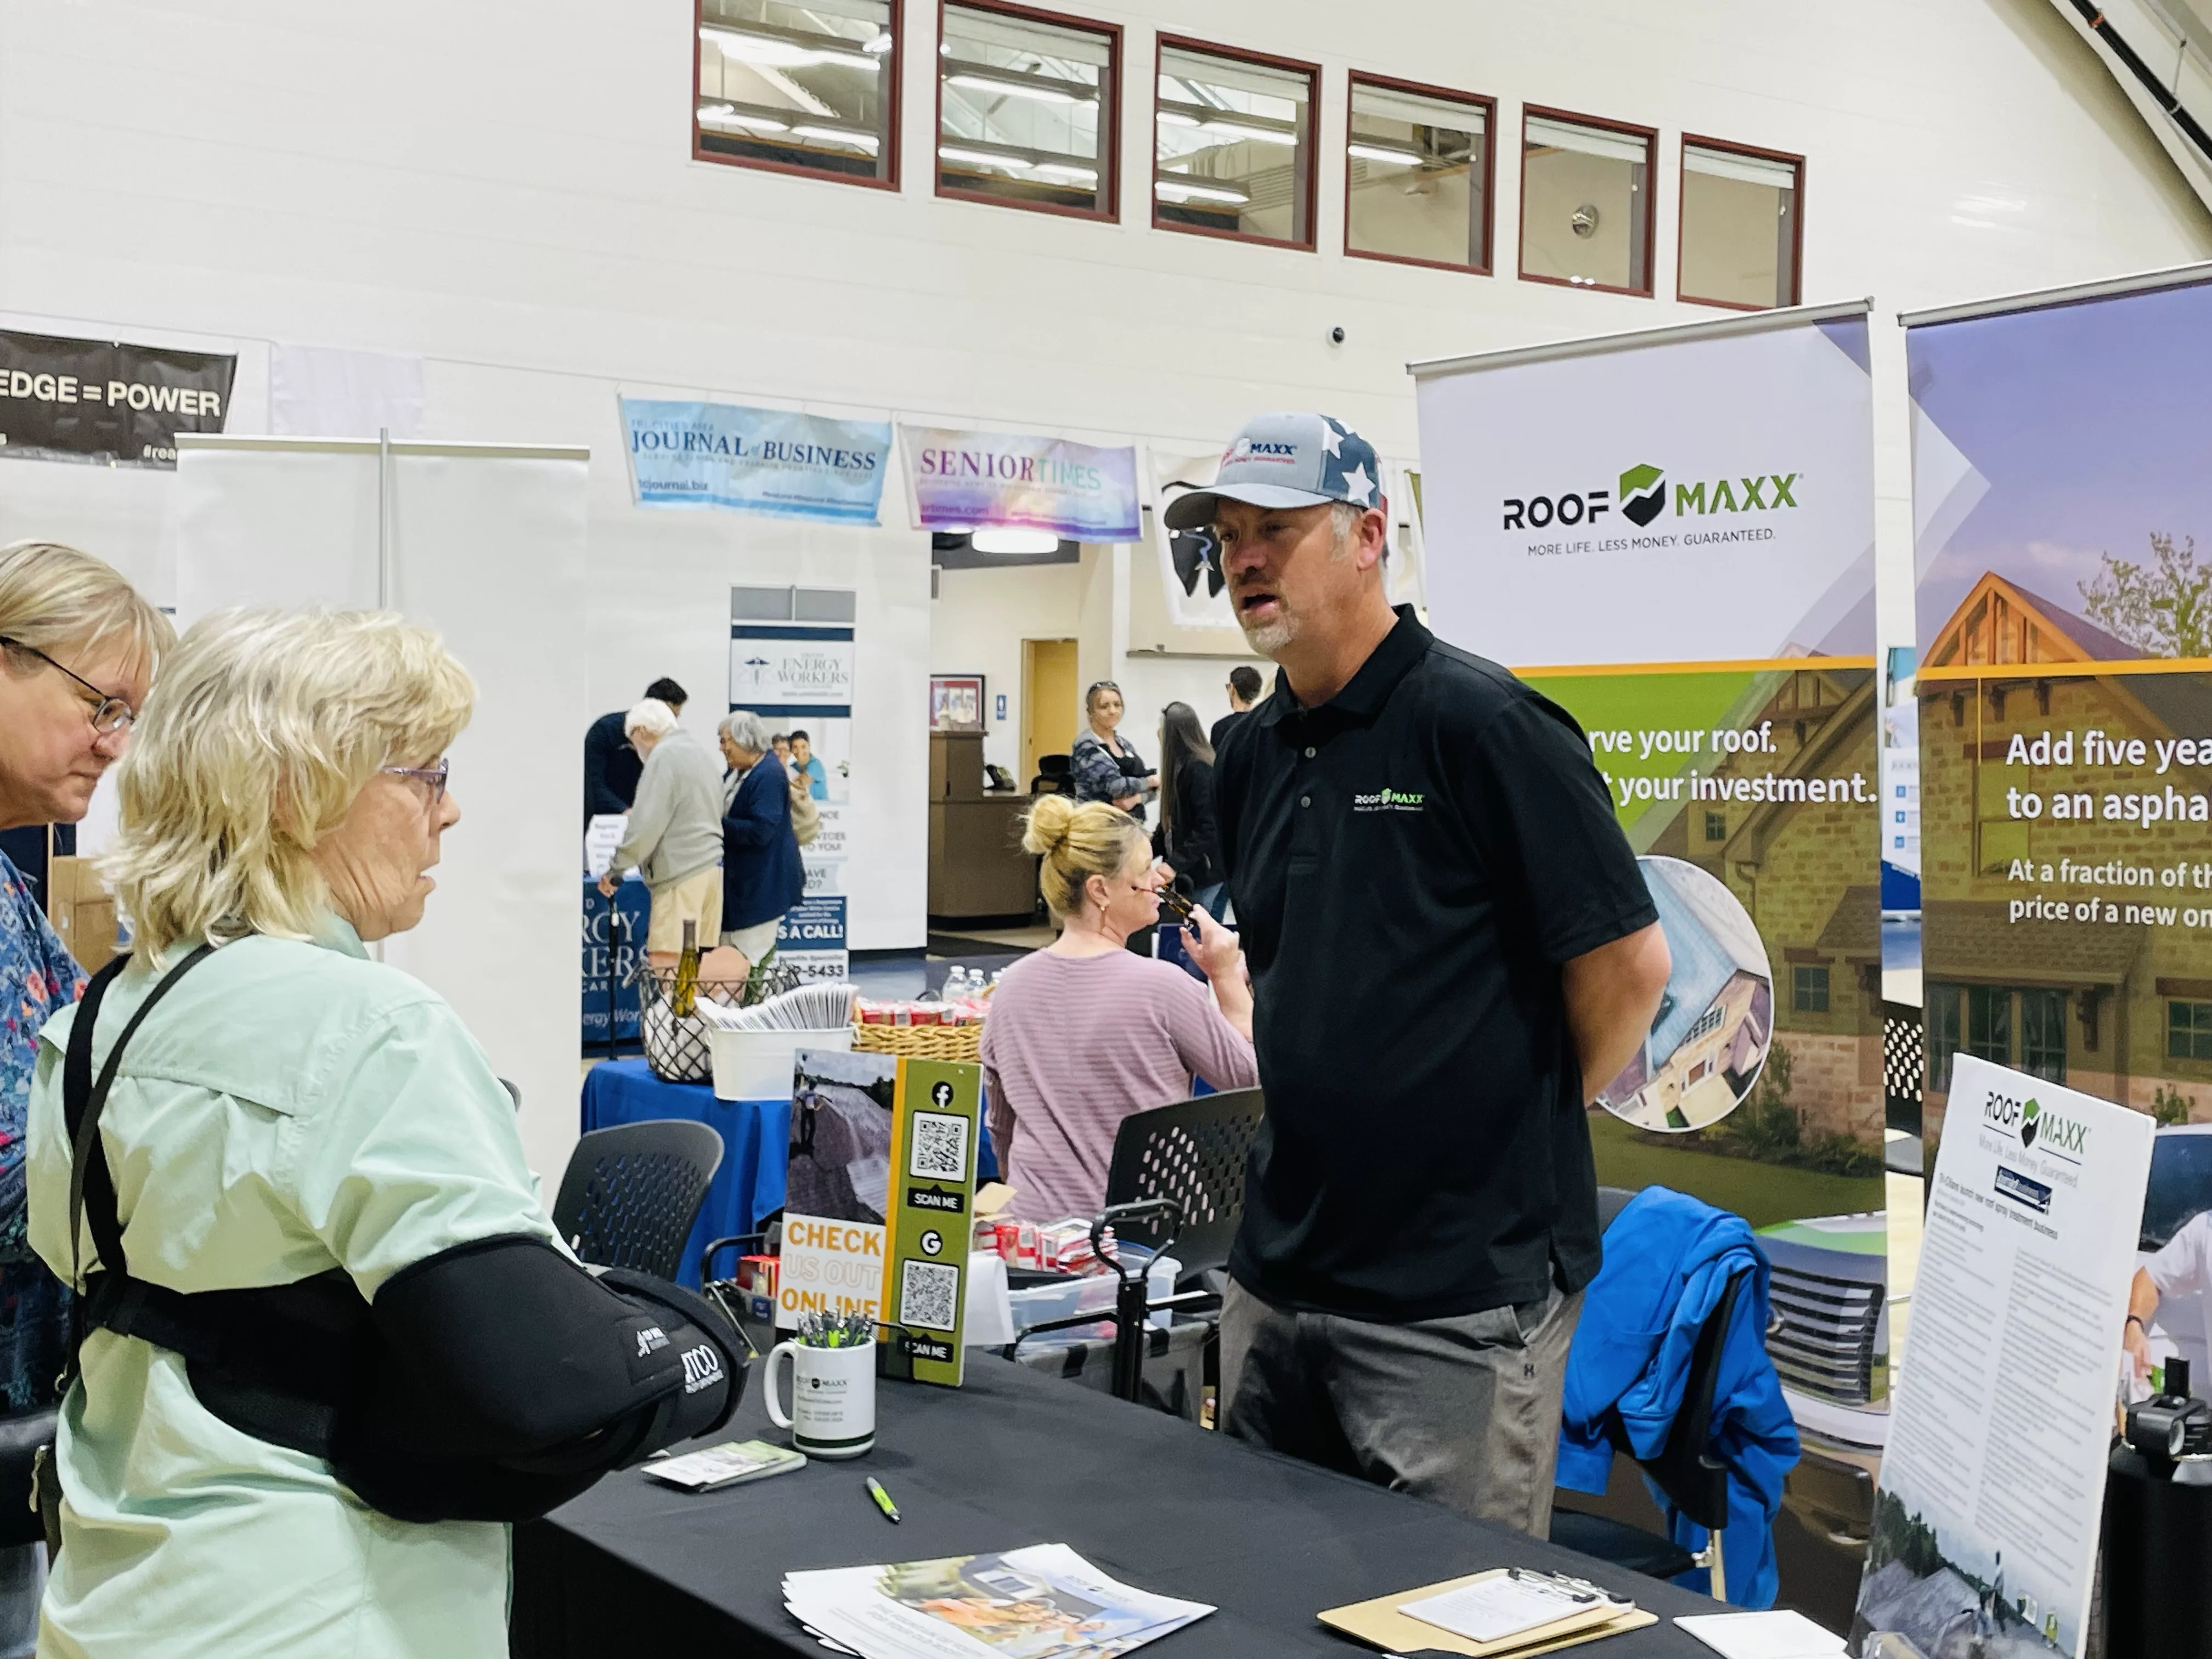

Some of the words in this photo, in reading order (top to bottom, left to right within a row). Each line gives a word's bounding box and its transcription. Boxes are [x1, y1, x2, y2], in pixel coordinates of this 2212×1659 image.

[108, 380, 221, 417] POWER
[632, 430, 749, 457] JOURNAL
[763, 441, 876, 470] BUSINESS
[1504, 491, 1609, 530] ROOF
[1527, 544, 1562, 556] MORE
[1566, 541, 1595, 554] LIFE.
[1598, 539, 1628, 552] LESS
[1632, 535, 1679, 549] MONEY.
[1684, 528, 1776, 545] GUARANTEED.
[777, 670, 849, 684] WORKERS
[782, 658, 843, 670] ENERGY
[1589, 730, 1633, 753] rve
[1639, 729, 1705, 760] your
[1711, 720, 1778, 753] roof.
[2006, 731, 2074, 766] Add
[2083, 730, 2147, 766] five
[2155, 738, 2212, 775] yea
[1618, 775, 1684, 806] your
[1690, 770, 1878, 803] investment.
[2006, 787, 2043, 820] to
[2051, 793, 2094, 821] an
[2103, 785, 2208, 829] aspha
[2008, 859, 2034, 883] At
[2040, 864, 2054, 883] a
[2059, 859, 2154, 887] fraction
[2161, 862, 2188, 888] of
[2010, 895, 2069, 924] price
[2075, 897, 2101, 923] of
[2104, 904, 2118, 924] a
[2125, 905, 2176, 926] new
[2183, 908, 2212, 927] on
[789, 925, 802, 939] A
[803, 924, 844, 939] CALL!
[1984, 1091, 2021, 1126] ROOF
[2040, 1111, 2087, 1154] MAXX
[914, 1193, 941, 1206] SCAN
[943, 1197, 958, 1209] ME
[788, 1221, 881, 1256] CHECK
[784, 1253, 820, 1282] US
[825, 1259, 882, 1291] OUT
